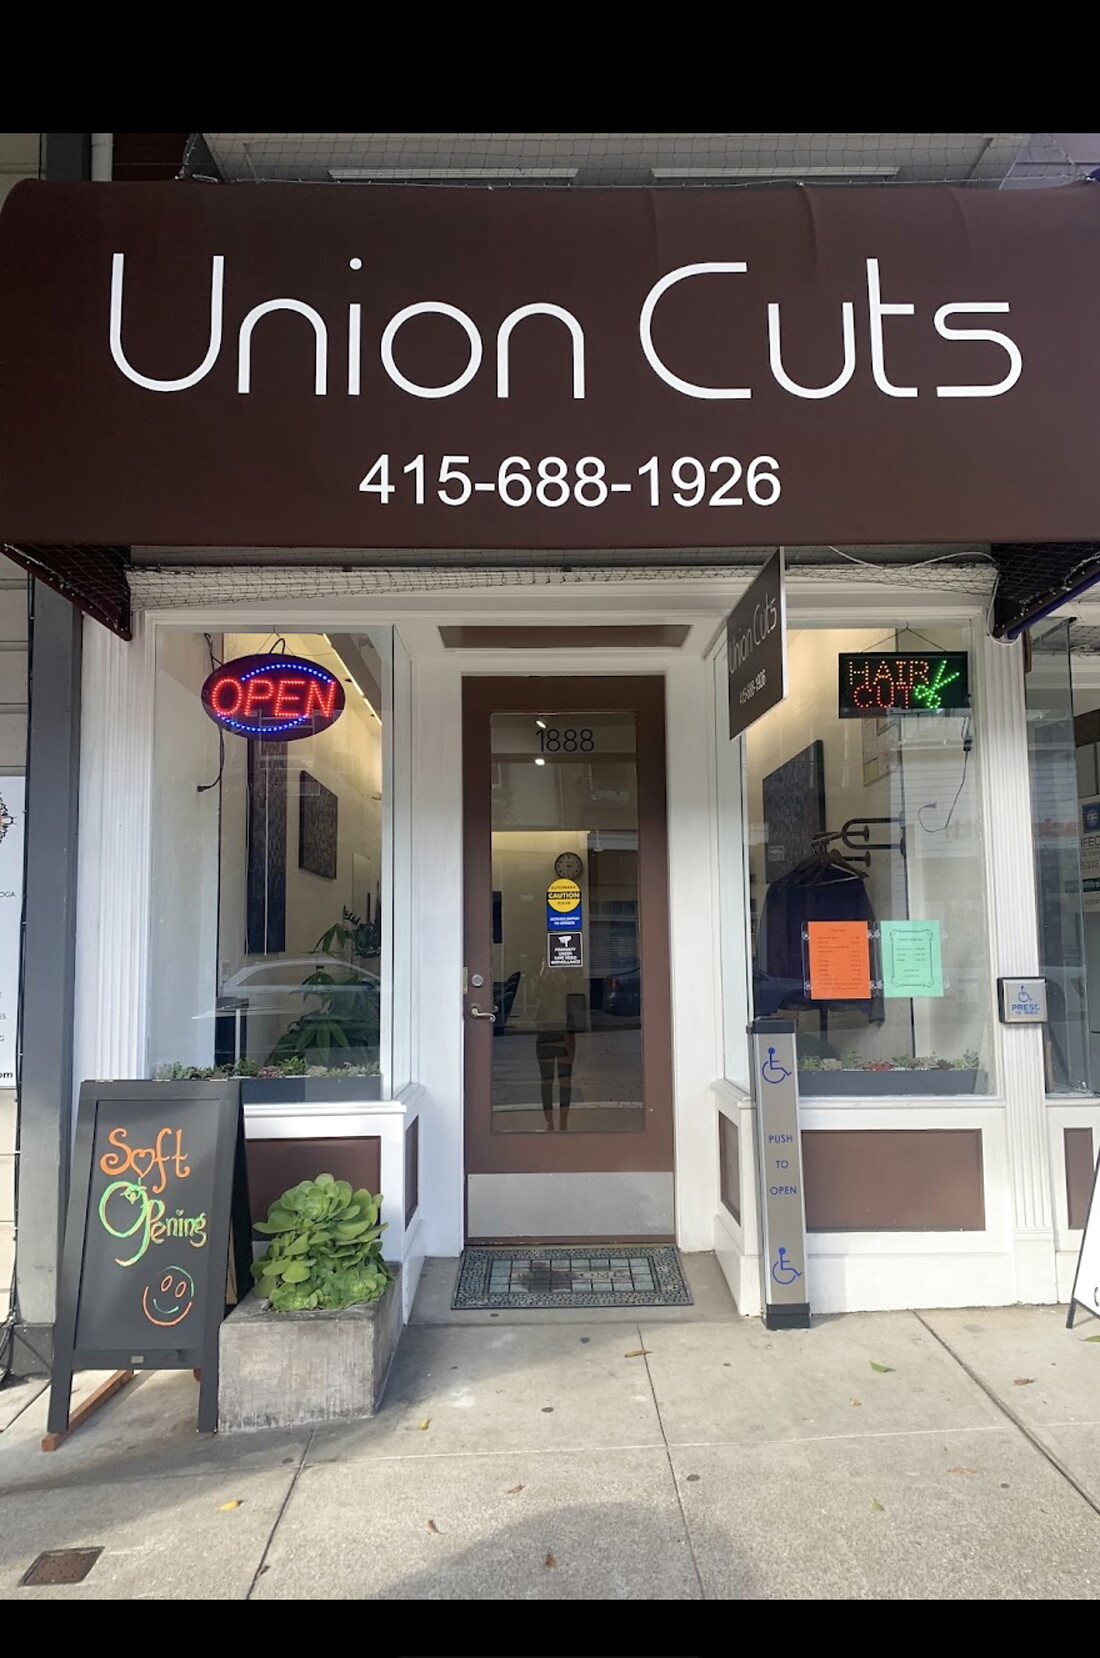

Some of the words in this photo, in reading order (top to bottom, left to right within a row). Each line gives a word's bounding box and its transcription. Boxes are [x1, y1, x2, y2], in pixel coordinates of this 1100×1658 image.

[109, 252, 585, 400] Union
[638, 257, 1023, 400] Cuts
[358, 453, 782, 508] 415-688-1926
[729, 628, 753, 674] Union
[753, 593, 777, 645] Cuts
[849, 660, 930, 685] HAIR
[210, 676, 337, 718] OPEN
[854, 684, 916, 709] CUT
[535, 728, 594, 752] 1888
[548, 891, 580, 899] CAUTION
[1011, 1003, 1041, 1012] PRESS
[768, 1134, 793, 1144] PUSH
[776, 1160, 790, 1169] TO
[769, 1186, 797, 1196] OPEN
